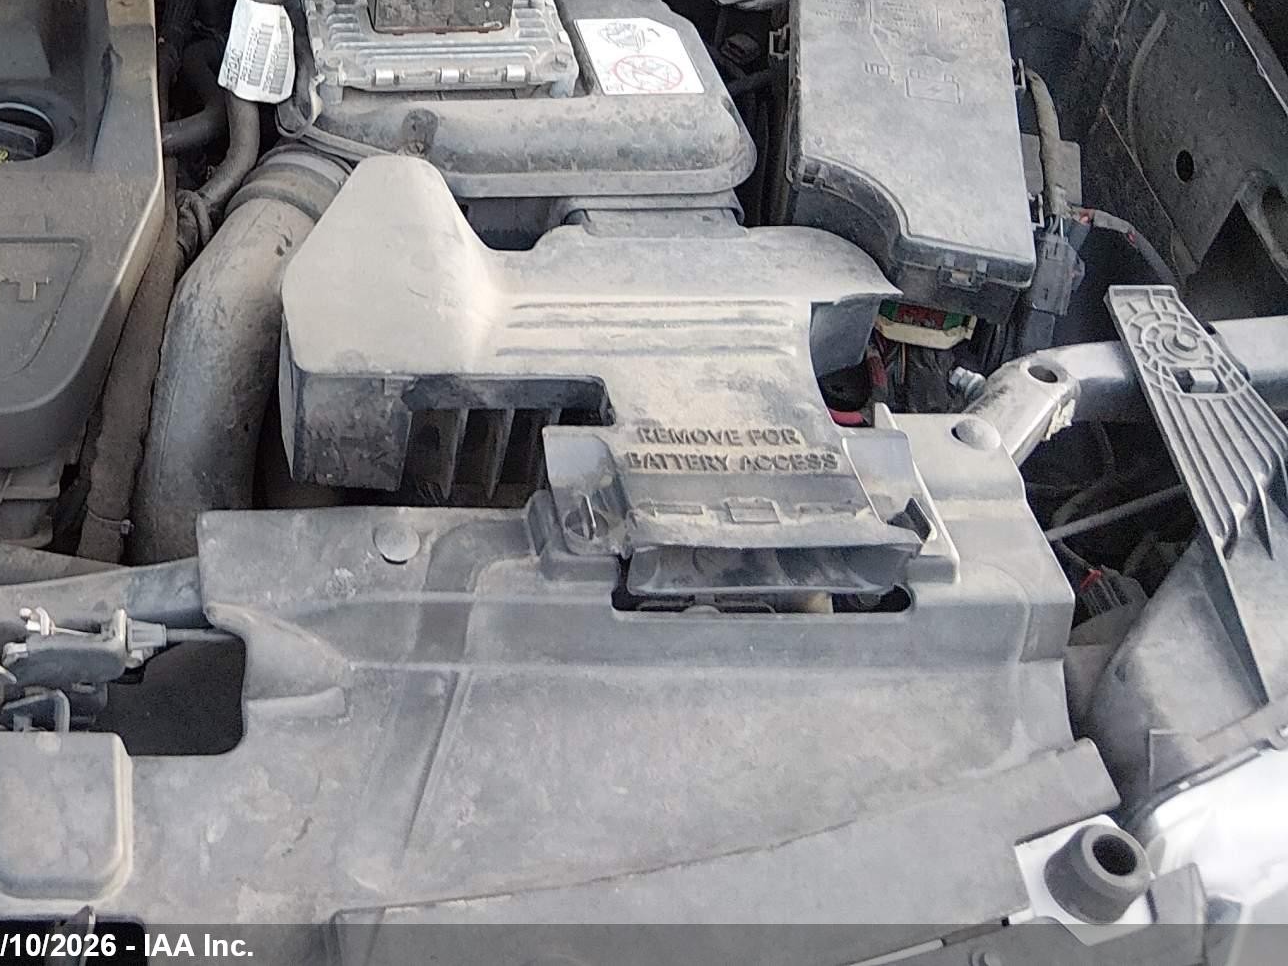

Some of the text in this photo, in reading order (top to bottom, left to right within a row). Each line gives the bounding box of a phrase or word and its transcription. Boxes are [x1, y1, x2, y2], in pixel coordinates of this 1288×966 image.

[636, 427, 801, 447] REMOVE FOR
[624, 451, 840, 472] BATTERY ACCESS
